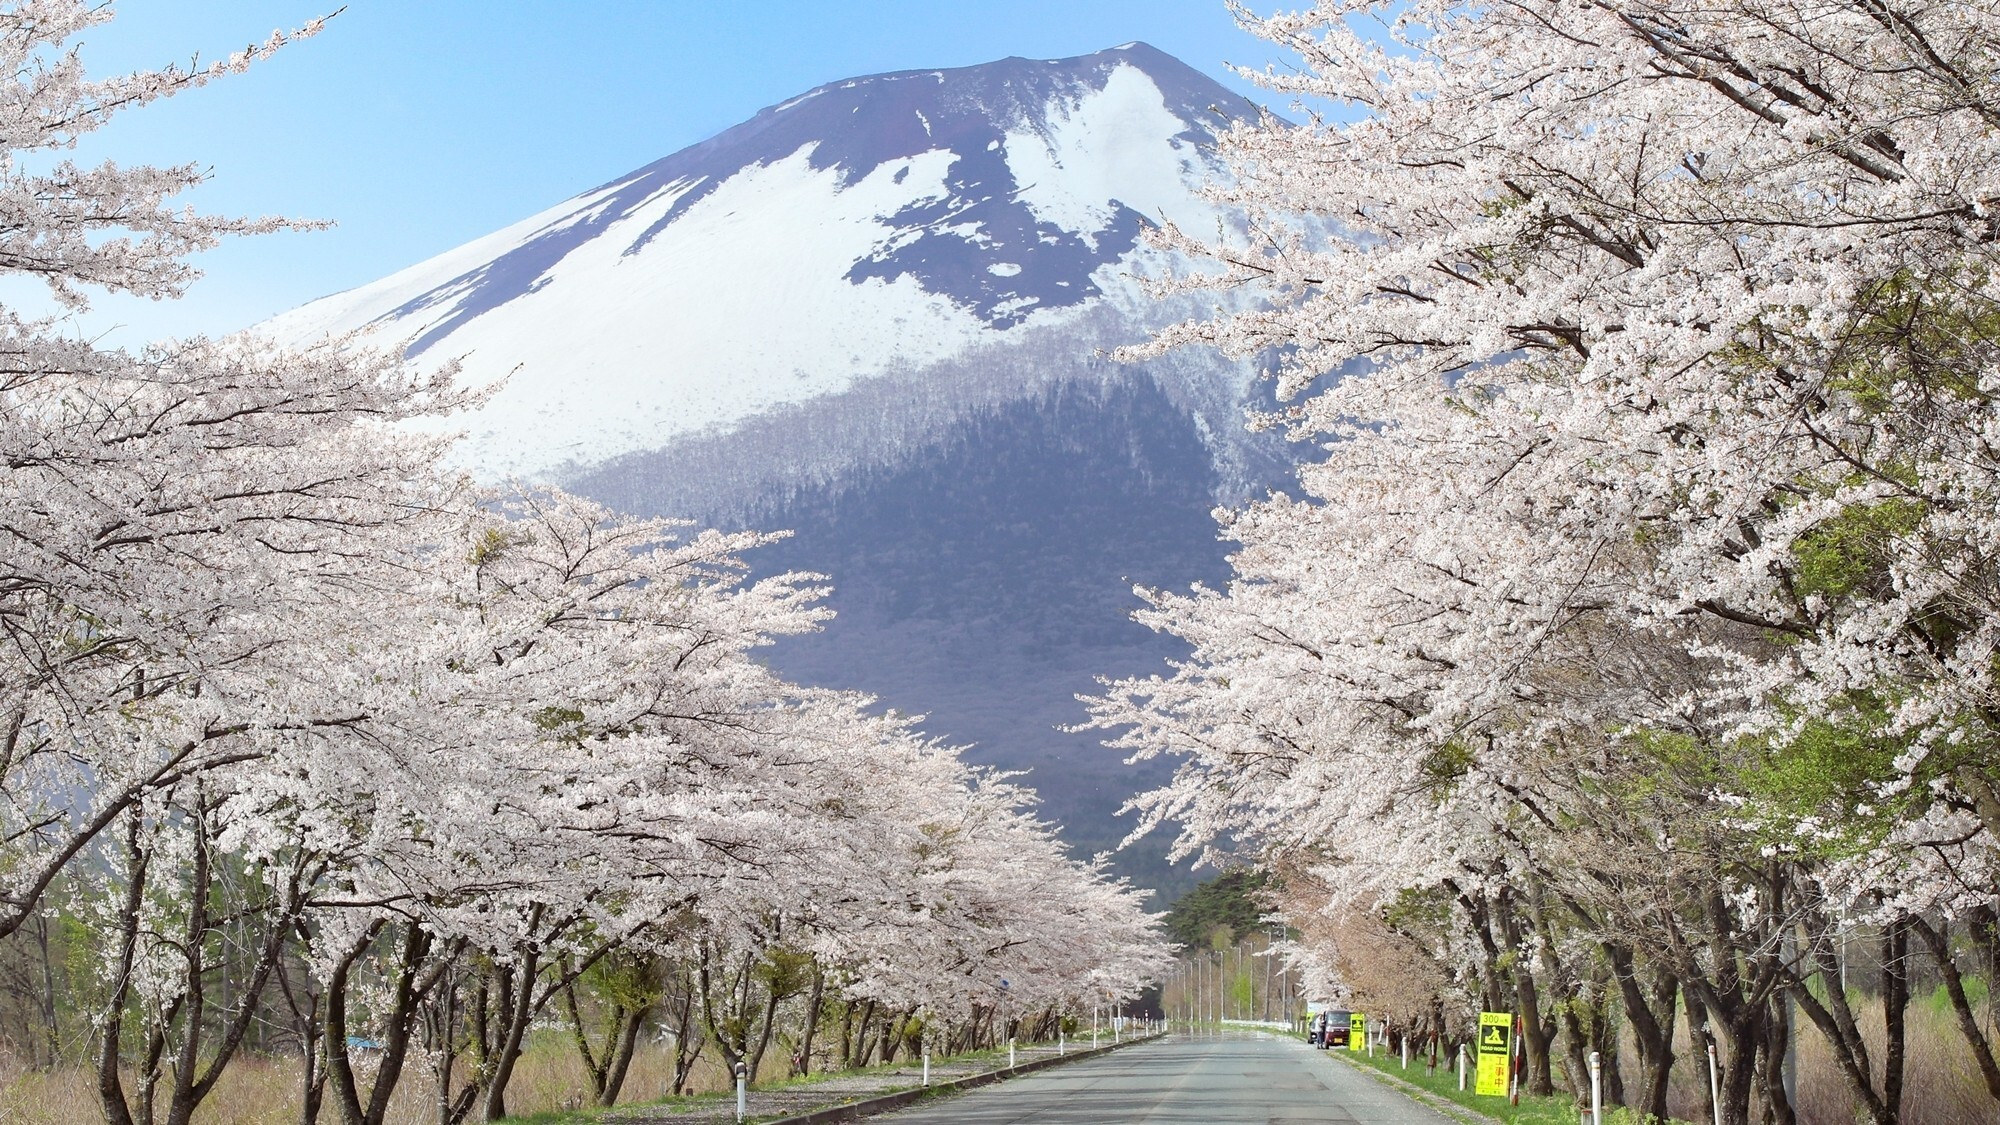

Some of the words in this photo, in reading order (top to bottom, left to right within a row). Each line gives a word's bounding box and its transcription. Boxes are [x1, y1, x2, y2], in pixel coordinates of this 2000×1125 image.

[1483, 1014, 1499, 1024] 300
[1494, 1056, 1505, 1087] 工事中
